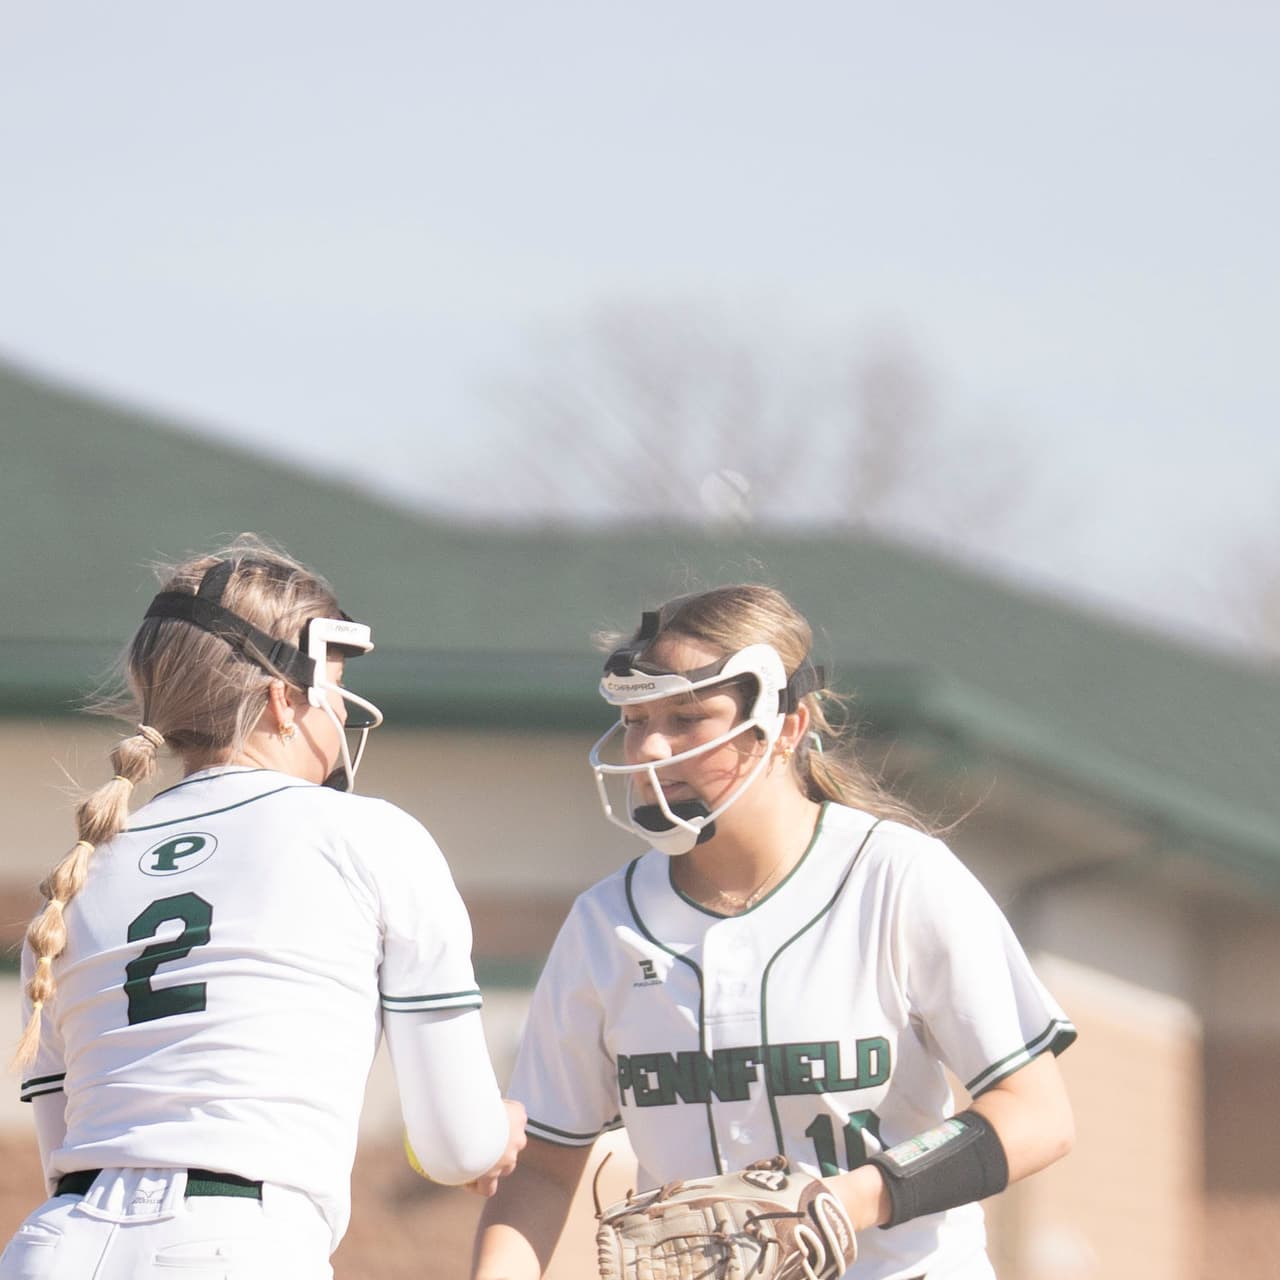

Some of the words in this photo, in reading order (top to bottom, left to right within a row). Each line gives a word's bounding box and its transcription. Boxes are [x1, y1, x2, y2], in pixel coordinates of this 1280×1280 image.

[150, 836, 206, 871] P
[123, 891, 213, 1026] 2
[617, 1036, 891, 1107] PENNFIELD
